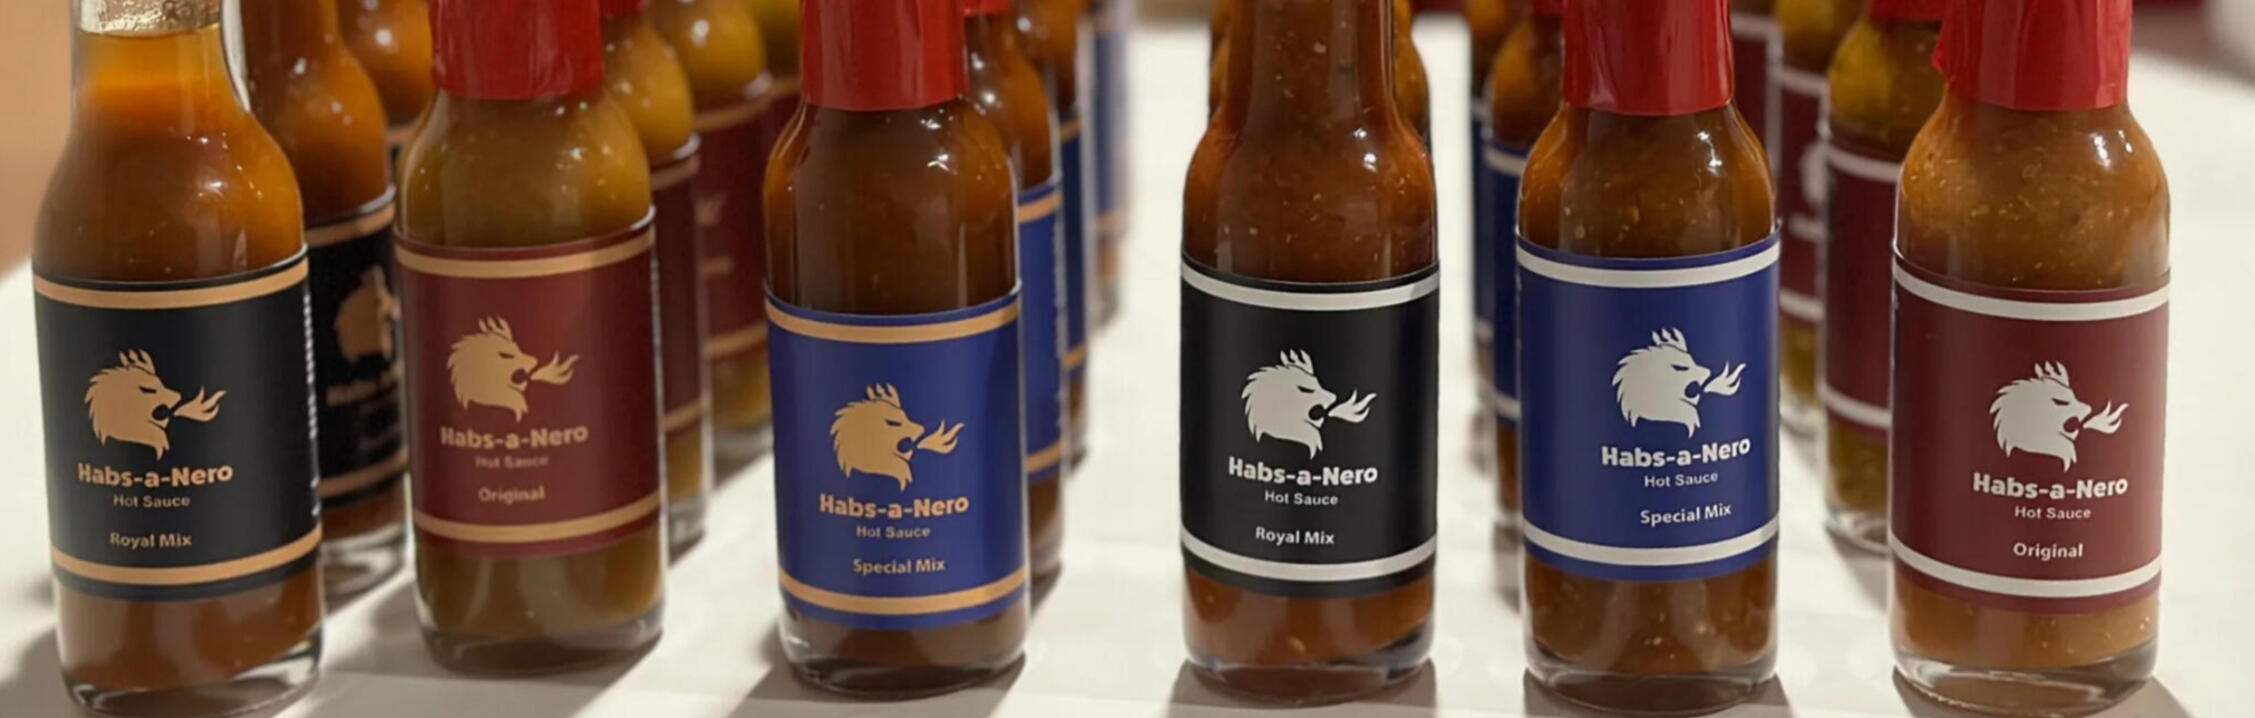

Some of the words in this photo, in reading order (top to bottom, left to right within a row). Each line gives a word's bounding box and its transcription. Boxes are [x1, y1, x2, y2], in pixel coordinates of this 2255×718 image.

[440, 425, 589, 450] Habs-a-Nero
[475, 455, 501, 468] Hot
[504, 454, 549, 468] Sauce
[1601, 438, 1751, 467] Habs-a-Nero
[78, 462, 234, 488] Habs-a-Nero
[1228, 456, 1378, 486] Habs-a-Nero
[1644, 474, 1670, 487] Hot
[1675, 471, 1718, 486] Sauce
[478, 485, 545, 504] Original
[1973, 472, 2128, 500] Habs-a-Nero
[113, 494, 139, 508] Hot
[142, 494, 190, 508] Sauce
[819, 493, 969, 519] Habs-a-Nero
[1264, 490, 1289, 504] Hot
[1294, 492, 1338, 506] Sauce
[1640, 508, 1700, 526] Special
[1704, 503, 1732, 520] Mix
[2014, 505, 2042, 519] Hot
[2046, 506, 2091, 520] Sauce
[110, 532, 155, 549] Royal
[159, 532, 192, 548] Mix
[856, 525, 882, 538] Hot
[885, 525, 931, 539] Sauce
[1255, 526, 1300, 546] Royal
[1304, 530, 1335, 545] Mix
[2013, 543, 2084, 561] Original
[853, 558, 912, 576] Special
[916, 558, 946, 573] Mix
